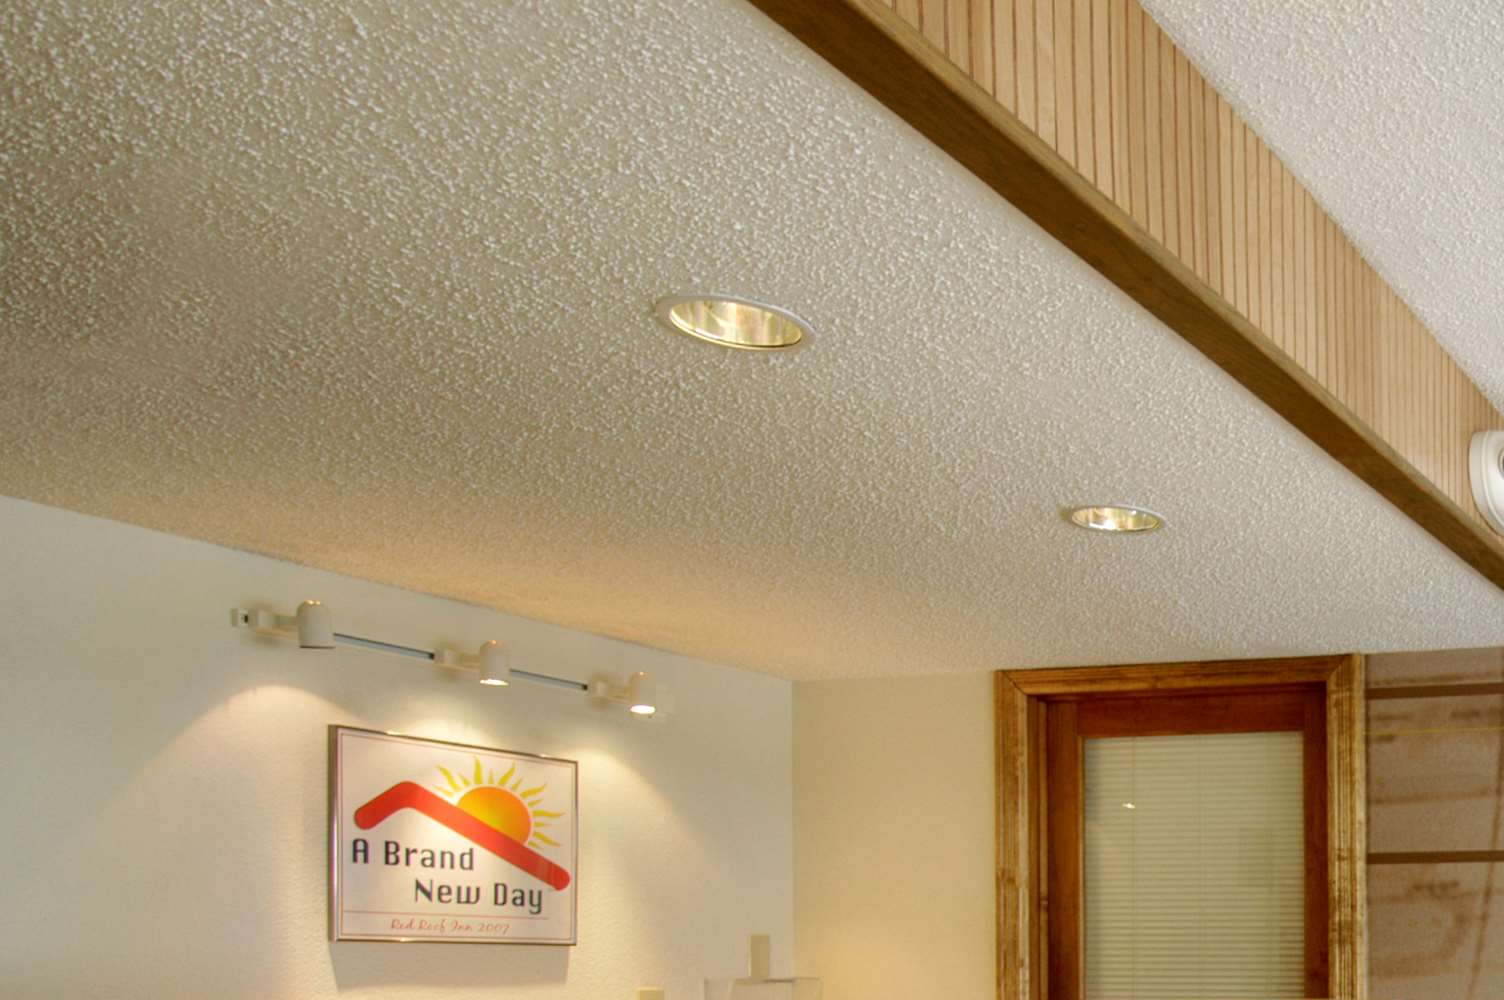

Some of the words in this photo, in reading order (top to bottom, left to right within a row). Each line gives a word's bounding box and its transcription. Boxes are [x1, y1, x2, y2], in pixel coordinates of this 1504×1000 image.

[352, 838, 369, 865] A
[384, 840, 474, 871] Brand
[414, 879, 481, 905] New
[494, 883, 543, 915] Day
[390, 918, 413, 931] Red
[451, 920, 473, 933] Inn
[478, 923, 510, 935] 2007
